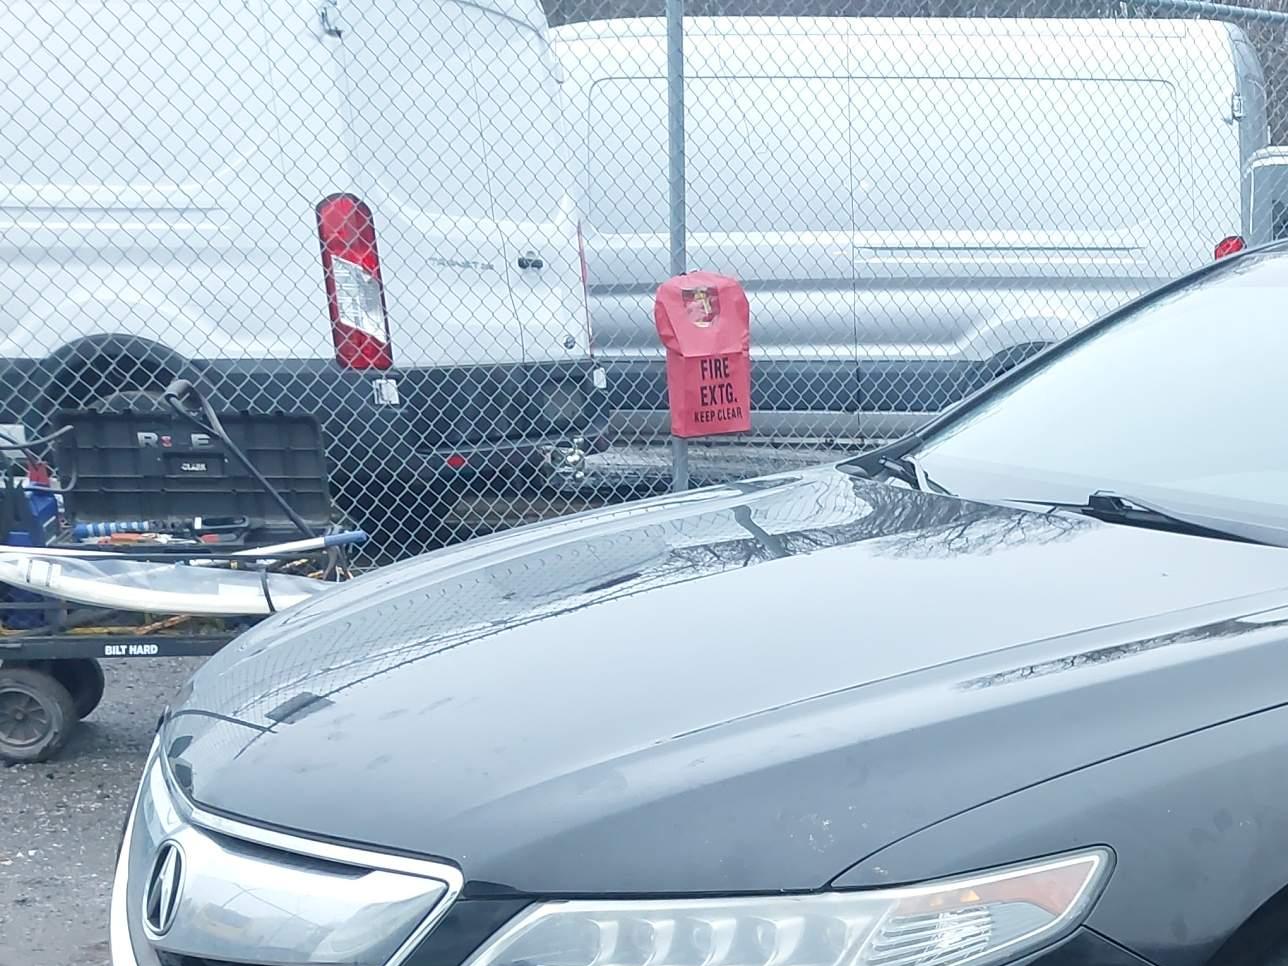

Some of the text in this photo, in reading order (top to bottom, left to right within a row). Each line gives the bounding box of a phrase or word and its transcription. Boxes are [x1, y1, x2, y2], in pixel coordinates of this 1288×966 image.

[700, 357, 730, 381] FIRE
[700, 383, 738, 408] EXTG.
[694, 406, 743, 424] KEEP CLEAR
[104, 644, 159, 656] BILT HARD
